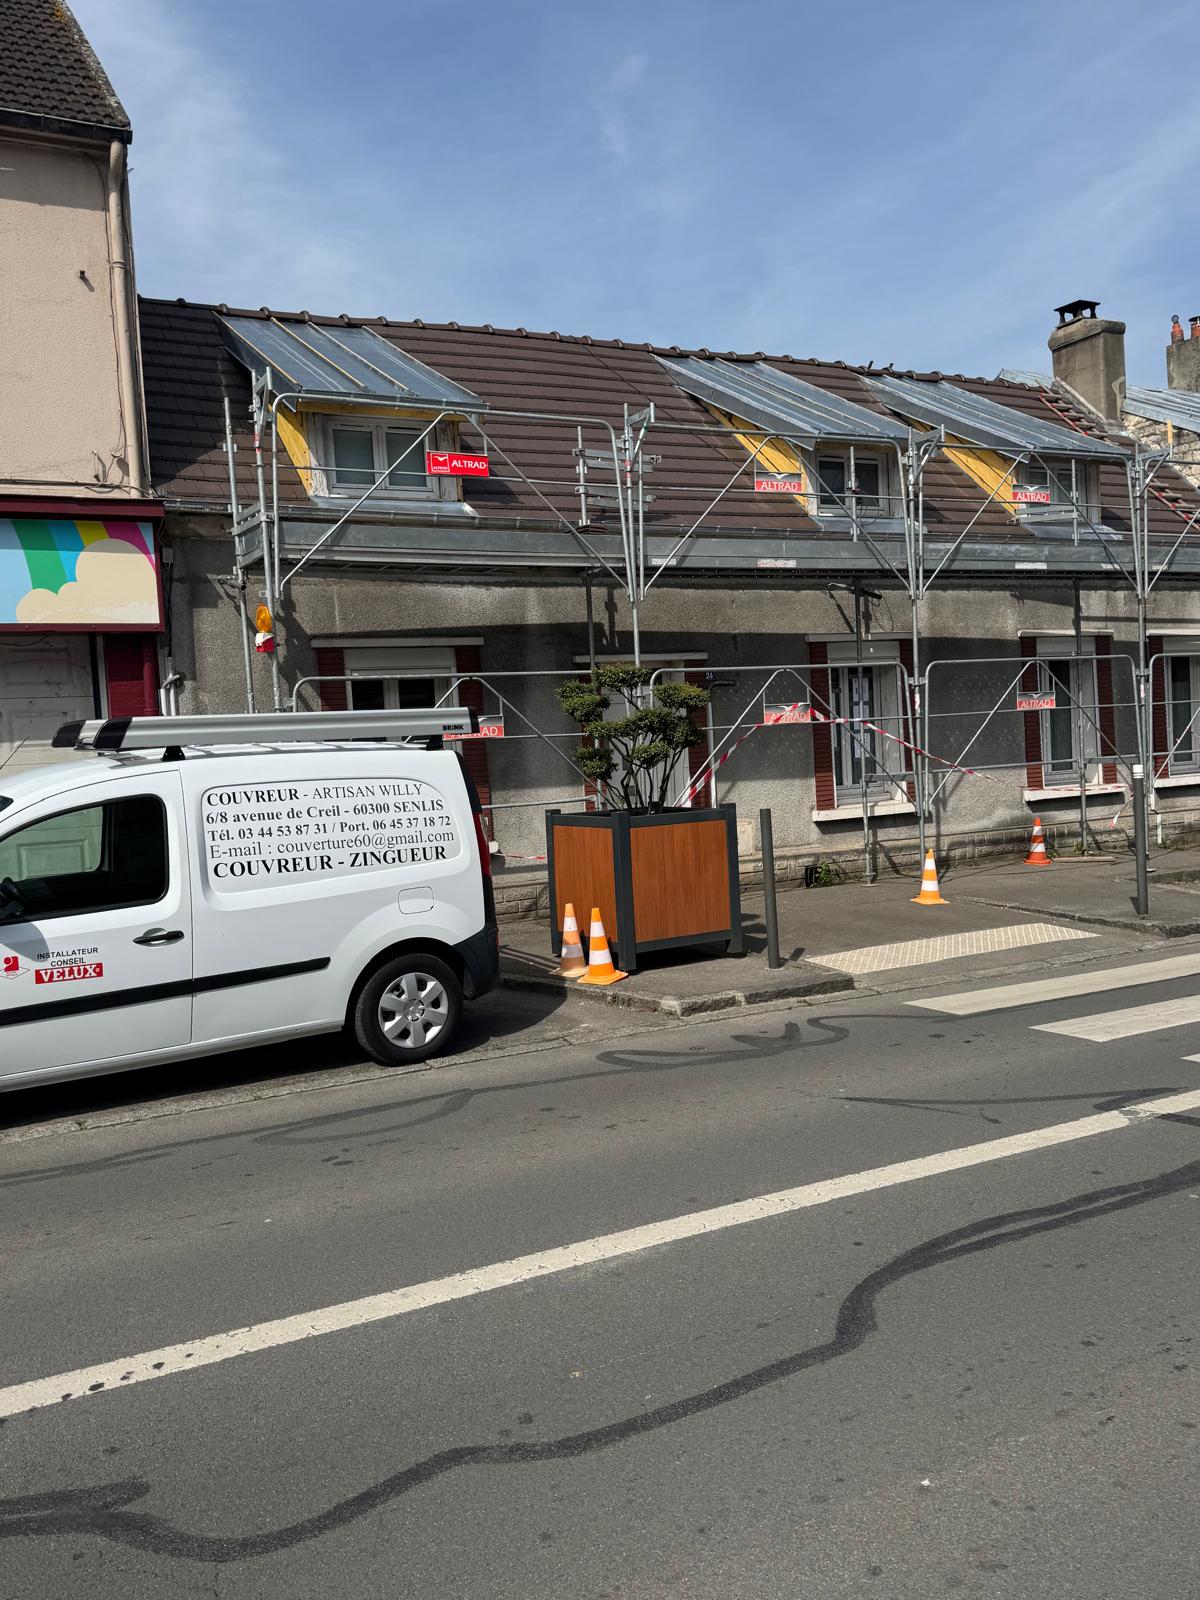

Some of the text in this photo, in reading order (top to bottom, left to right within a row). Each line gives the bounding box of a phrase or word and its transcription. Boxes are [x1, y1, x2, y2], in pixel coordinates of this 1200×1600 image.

[451, 459, 487, 469] ALTRAD
[760, 481, 798, 491] ALTRAD
[1016, 492, 1047, 502] ALTRAD
[1021, 700, 1051, 708] ALTRAD
[206, 788, 300, 806] COUVREUR
[312, 785, 375, 800] ARTISAN
[378, 783, 422, 797] WILLY
[206, 811, 228, 824] 6/8
[232, 810, 283, 823] avenue
[286, 807, 303, 819] de
[306, 805, 341, 818] Creil
[353, 802, 390, 816] 60300
[393, 799, 444, 813] SENLIS
[207, 829, 234, 841] Tél.
[238, 827, 254, 840] 03
[257, 826, 273, 838] 44
[276, 825, 292, 837] 53
[295, 824, 310, 836] 87
[313, 823, 328, 835] 31
[340, 822, 370, 833] Port.
[372, 819, 387, 831] 06
[389, 818, 403, 829] 45
[406, 817, 419, 829] 37
[423, 816, 435, 828] 18
[438, 815, 451, 827] 72
[210, 841, 262, 859] E-mail
[277, 830, 455, 854] couverture60@gmail.com
[213, 854, 333, 878] COUVREUR
[349, 845, 447, 868] ZINGUEUR
[37, 947, 99, 960] INSTALLATEUR
[50, 957, 87, 968] CONSEIL
[40, 964, 97, 983] VELUX
